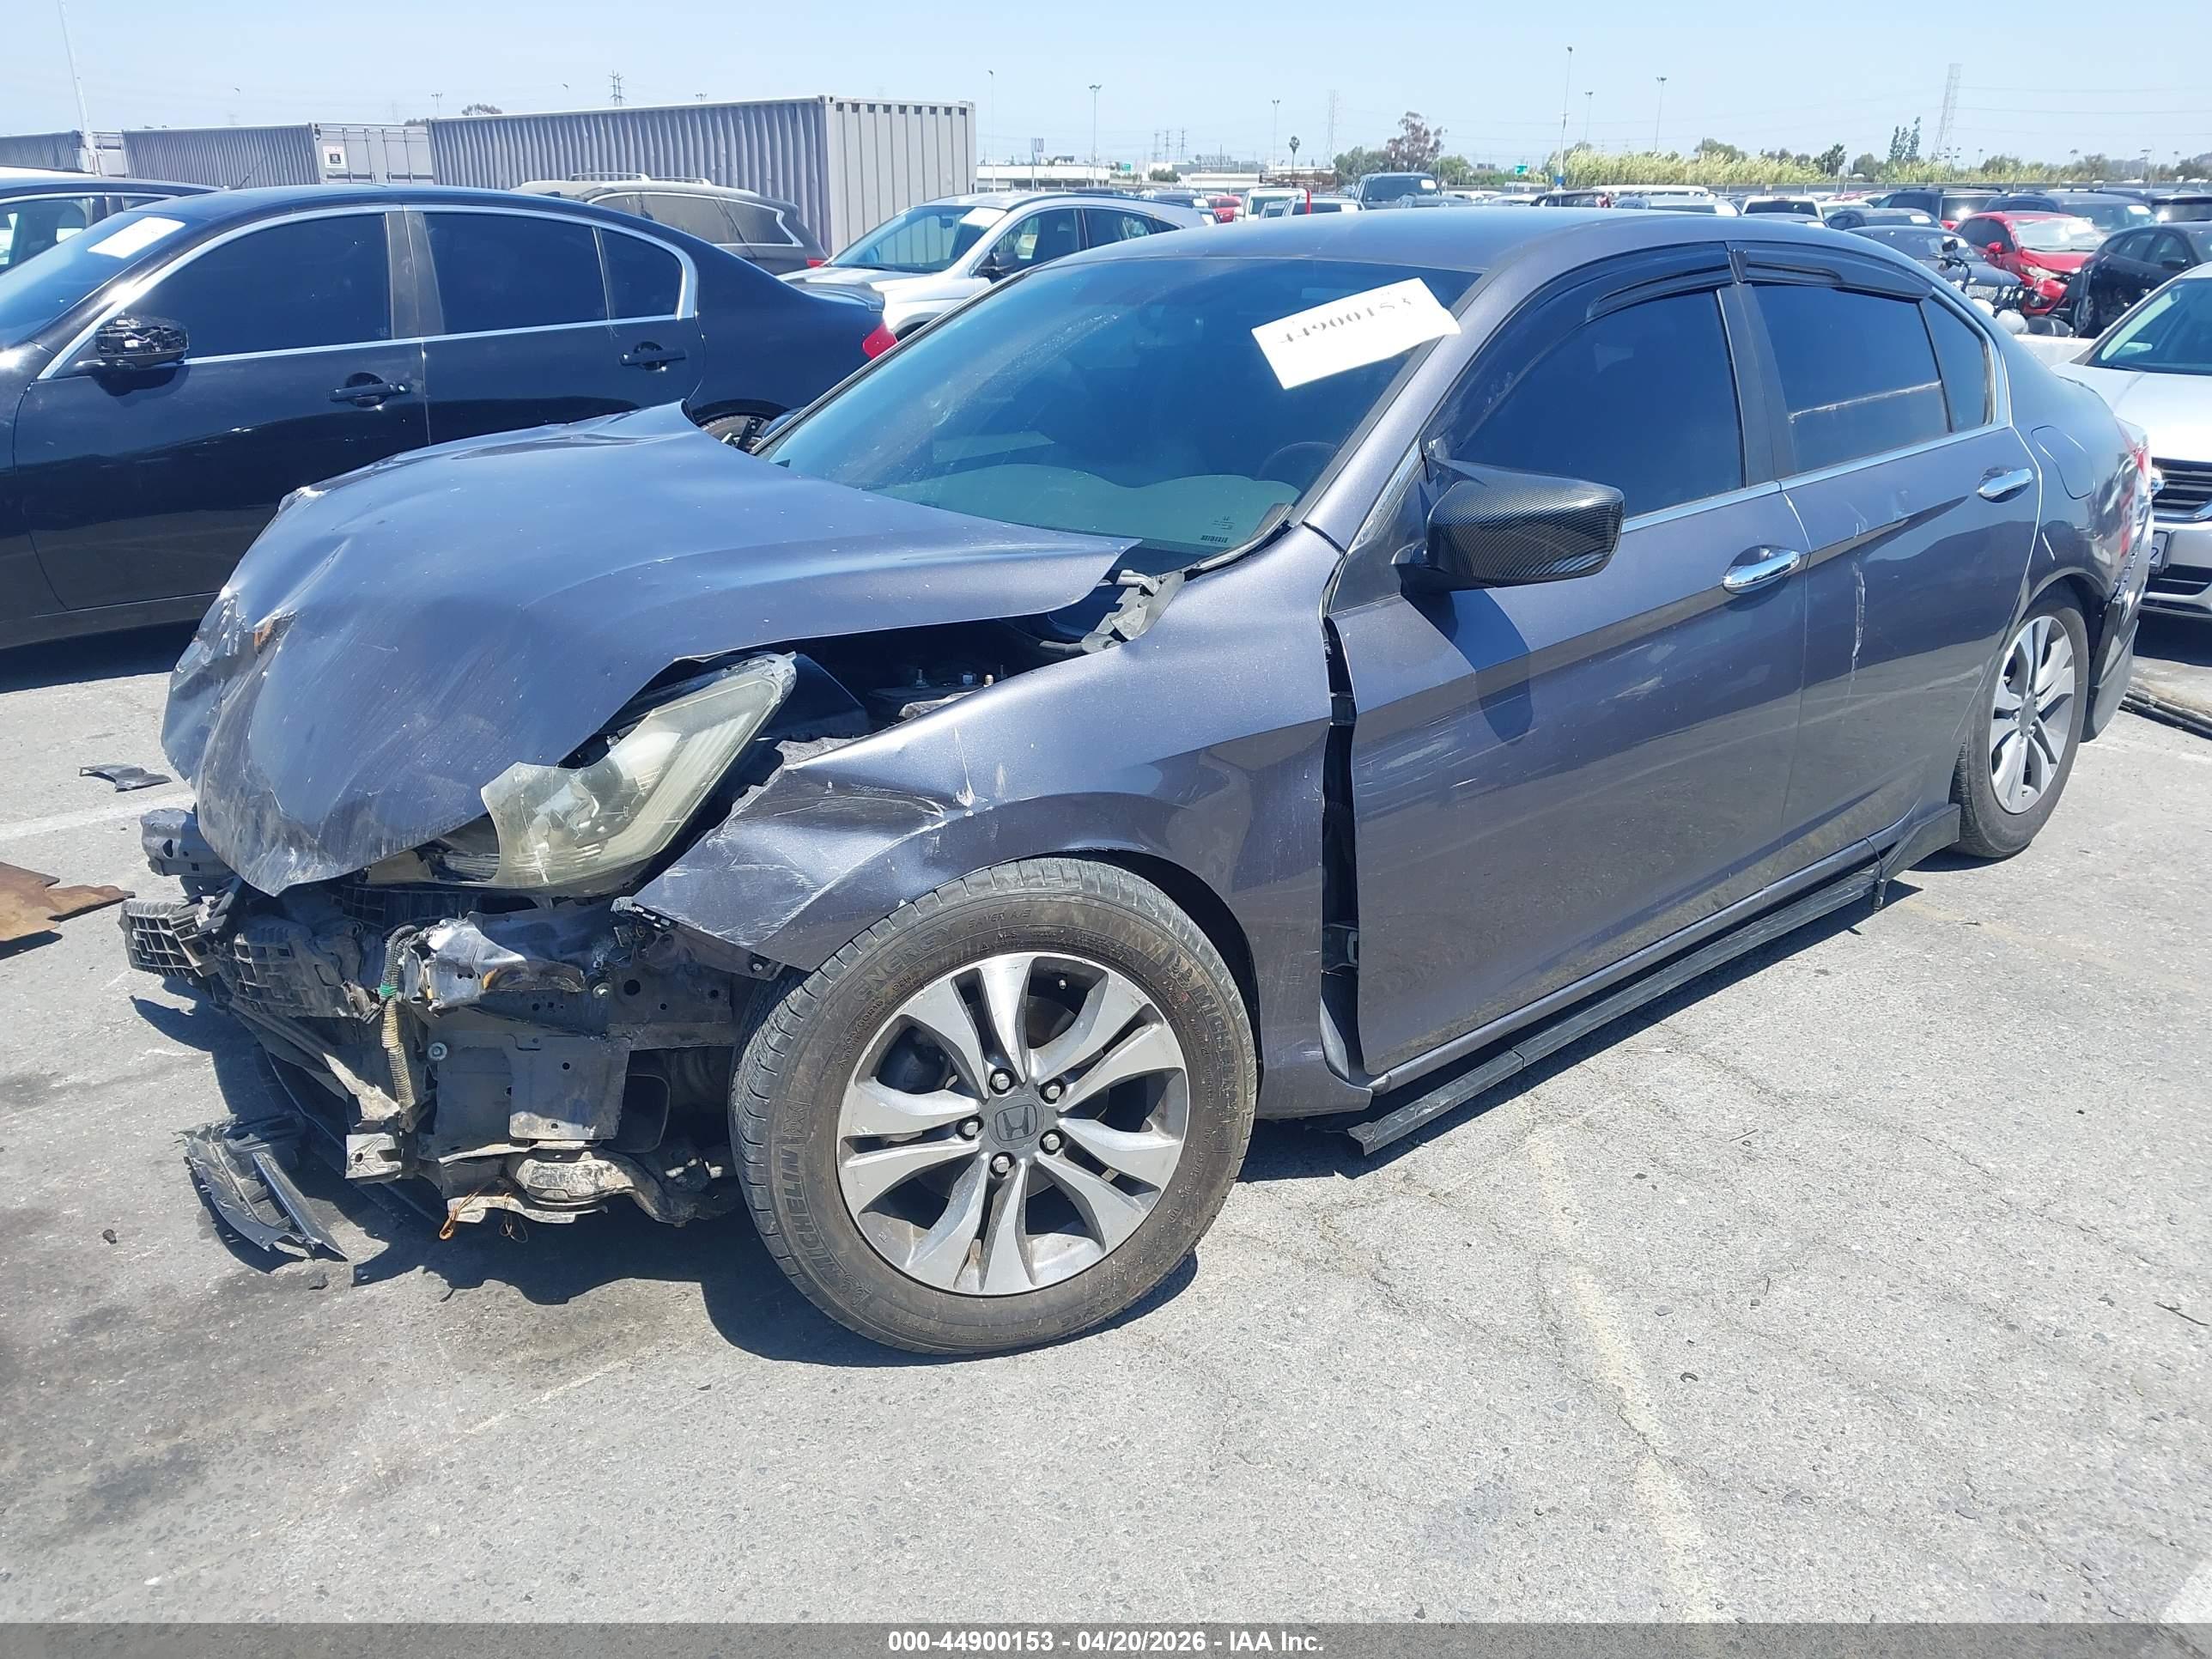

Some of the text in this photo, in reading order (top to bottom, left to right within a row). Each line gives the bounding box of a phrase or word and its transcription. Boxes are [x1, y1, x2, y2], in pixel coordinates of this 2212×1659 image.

[853, 921, 956, 1003] ENERGY
[968, 911, 1005, 929] SAVER
[781, 1146, 840, 1279] MICHELIN
